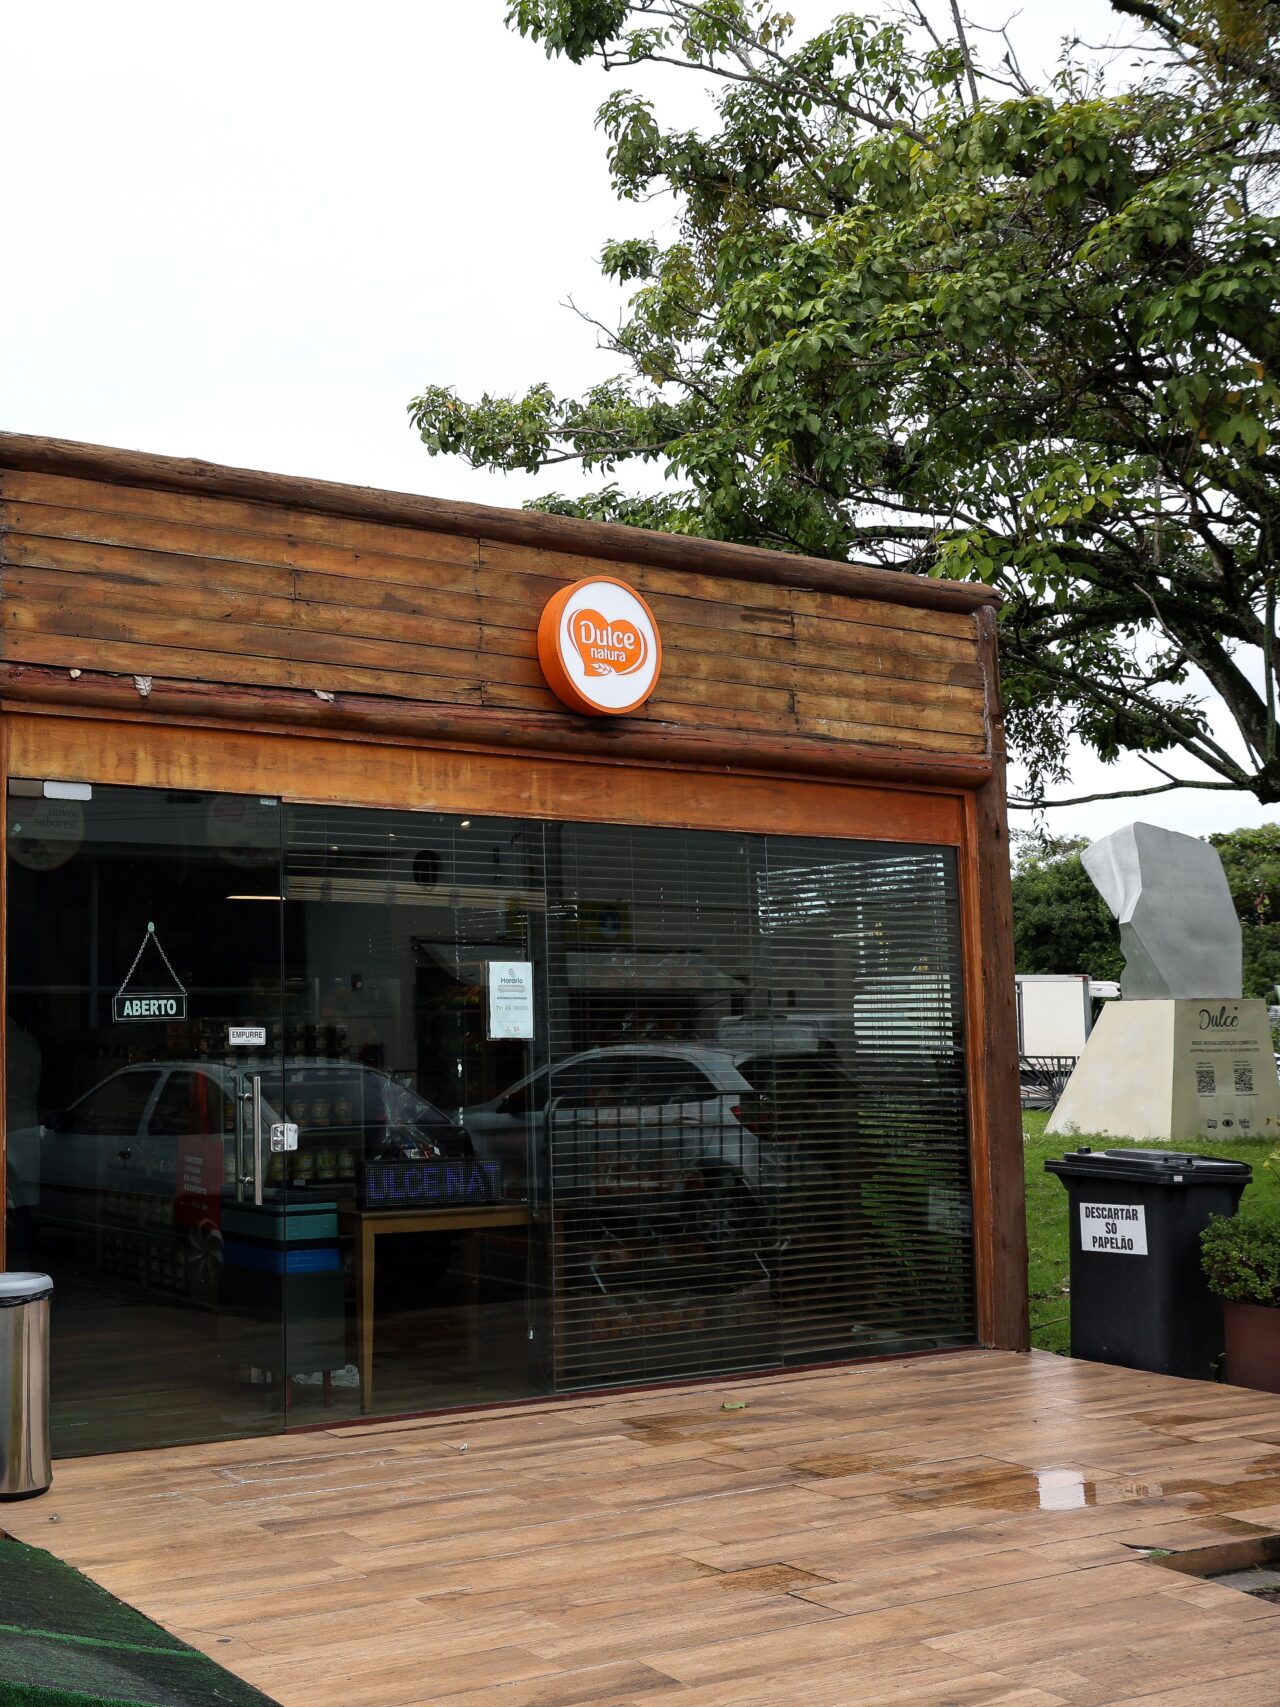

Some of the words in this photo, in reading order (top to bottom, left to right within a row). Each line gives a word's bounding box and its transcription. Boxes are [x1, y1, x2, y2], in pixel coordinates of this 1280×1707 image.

[579, 620, 635, 649] Dulce
[590, 647, 626, 662] natura
[123, 999, 177, 1016] ABERTO
[1199, 1006, 1239, 1030] Dulce
[232, 1031, 263, 1039] EMPURRE
[1105, 1219, 1117, 1234] SÓ
[1092, 1235, 1134, 1251] PAPELÃO
